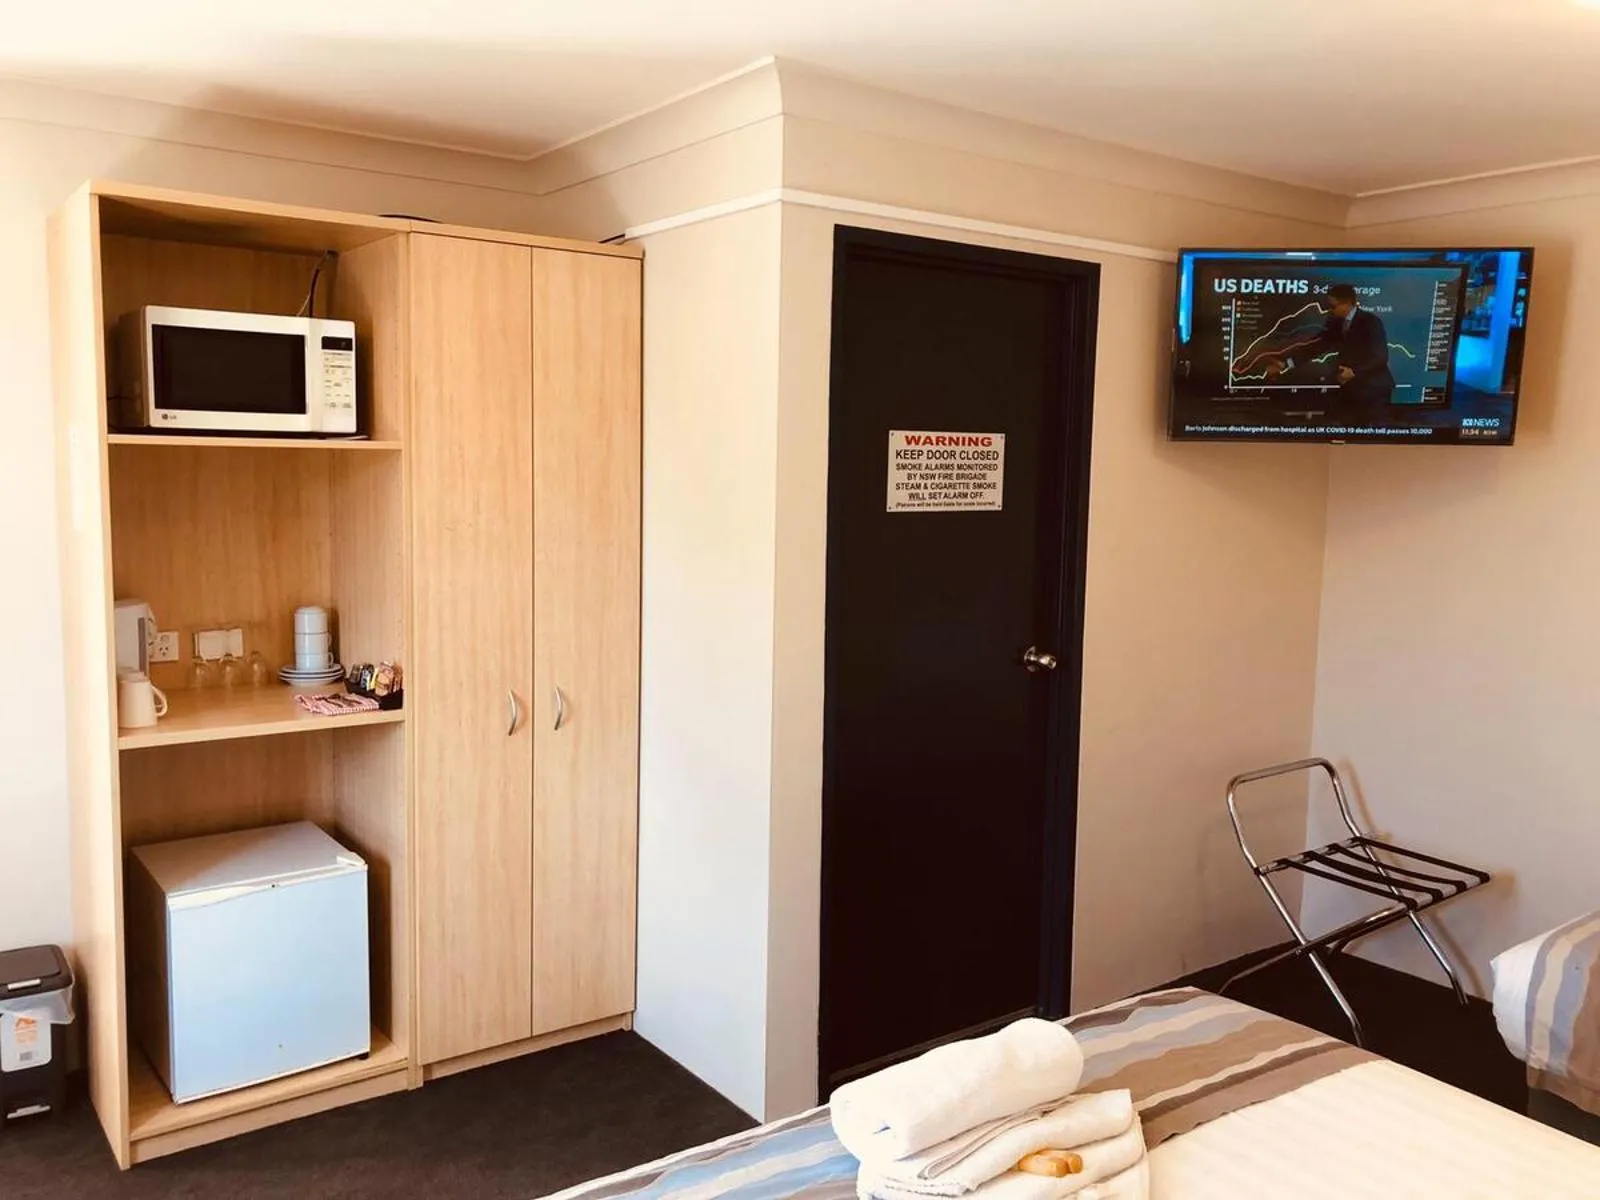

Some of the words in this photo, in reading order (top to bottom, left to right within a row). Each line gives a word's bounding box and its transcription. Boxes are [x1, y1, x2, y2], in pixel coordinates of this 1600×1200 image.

[1214, 278, 1237, 293] US
[1240, 279, 1309, 294] DEATHS
[1474, 418, 1500, 427] NEWS
[1202, 424, 1228, 433] Johnson
[1228, 425, 1264, 434] discharged
[1281, 426, 1307, 434] hospital
[904, 435, 993, 447] WARNING
[895, 449, 924, 460] KEEP
[926, 450, 957, 460] DOOR
[959, 450, 999, 461] CLOSED
[895, 463, 923, 471] SMOKE
[924, 463, 955, 471] ALARMS
[956, 463, 998, 471] MONITORED
[895, 482, 922, 490] STEAM
[923, 482, 929, 490] &
[930, 482, 970, 490] CIGARETTE
[908, 492, 926, 501] WILL
[928, 492, 943, 500] SET
[943, 492, 968, 500] ALARM
